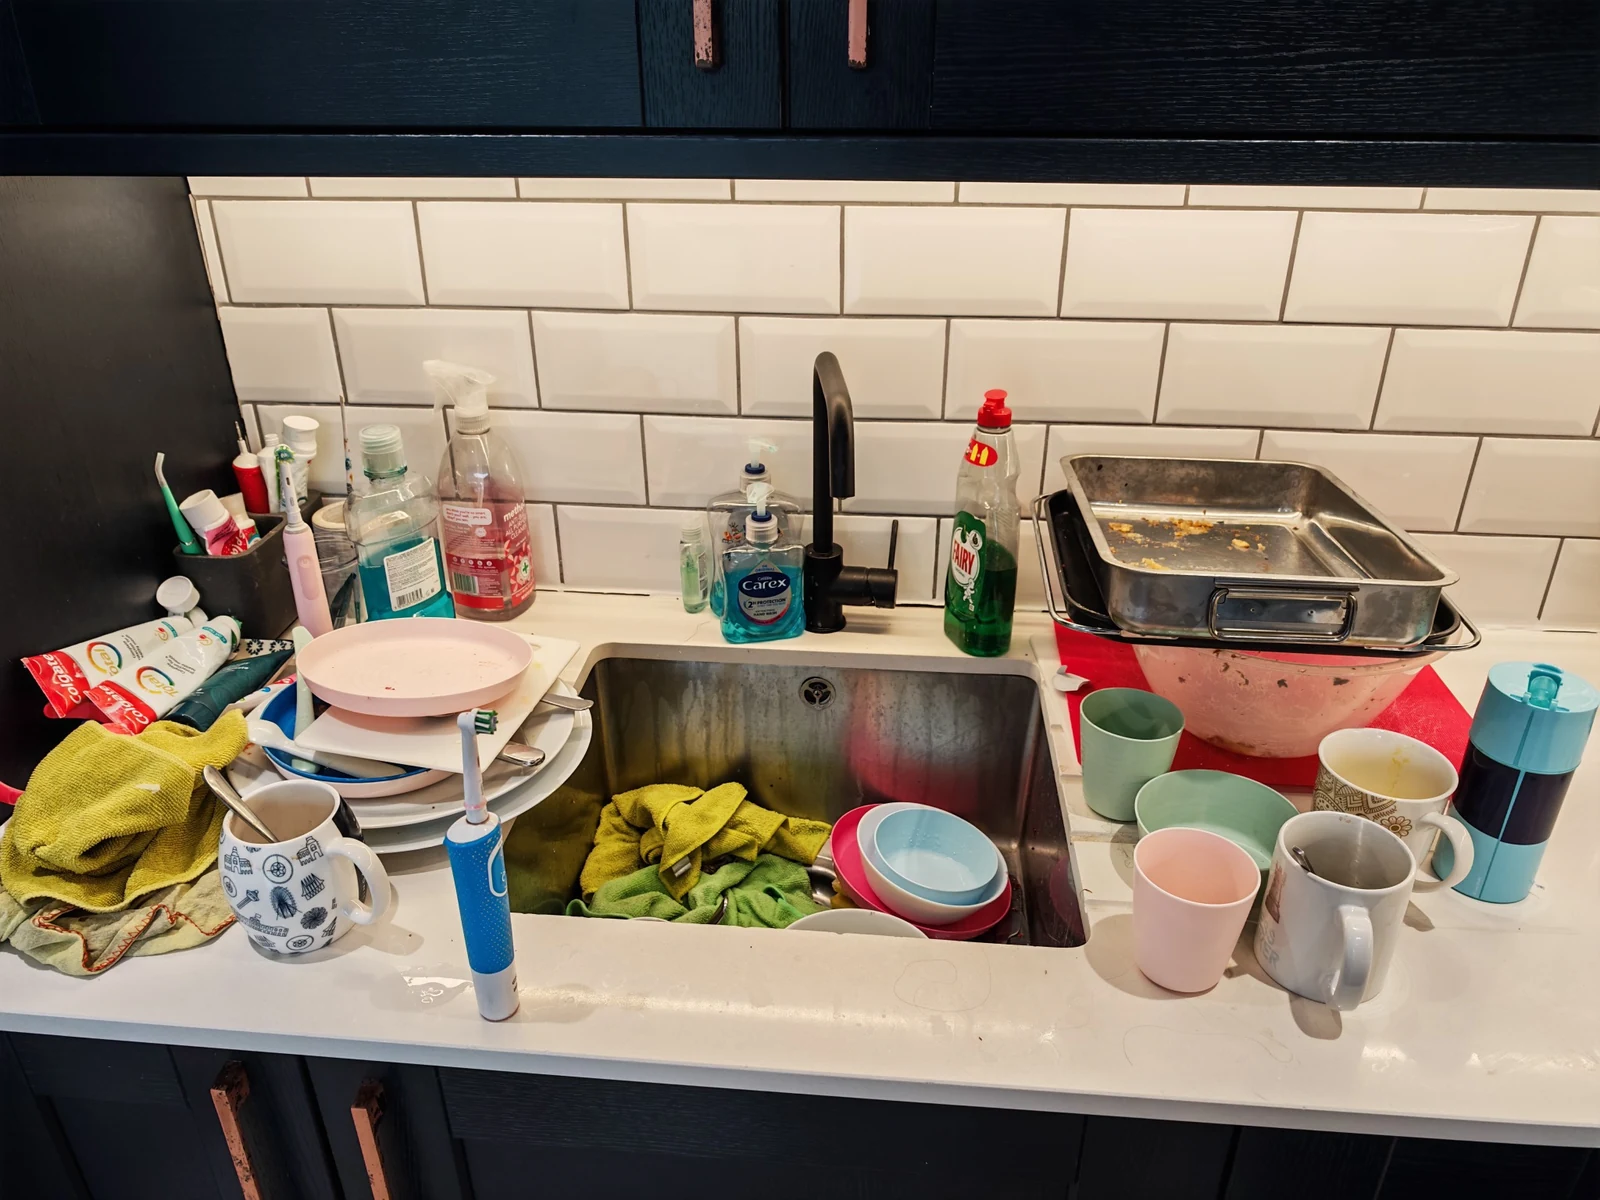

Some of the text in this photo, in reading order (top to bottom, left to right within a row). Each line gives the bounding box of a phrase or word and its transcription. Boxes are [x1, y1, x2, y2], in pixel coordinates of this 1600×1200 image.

[952, 539, 975, 576] FAIRY
[742, 579, 787, 590] Carex
[93, 648, 119, 676] otal
[42, 653, 82, 704] Colgate
[143, 674, 178, 697] Total
[98, 685, 150, 725] Colgate
